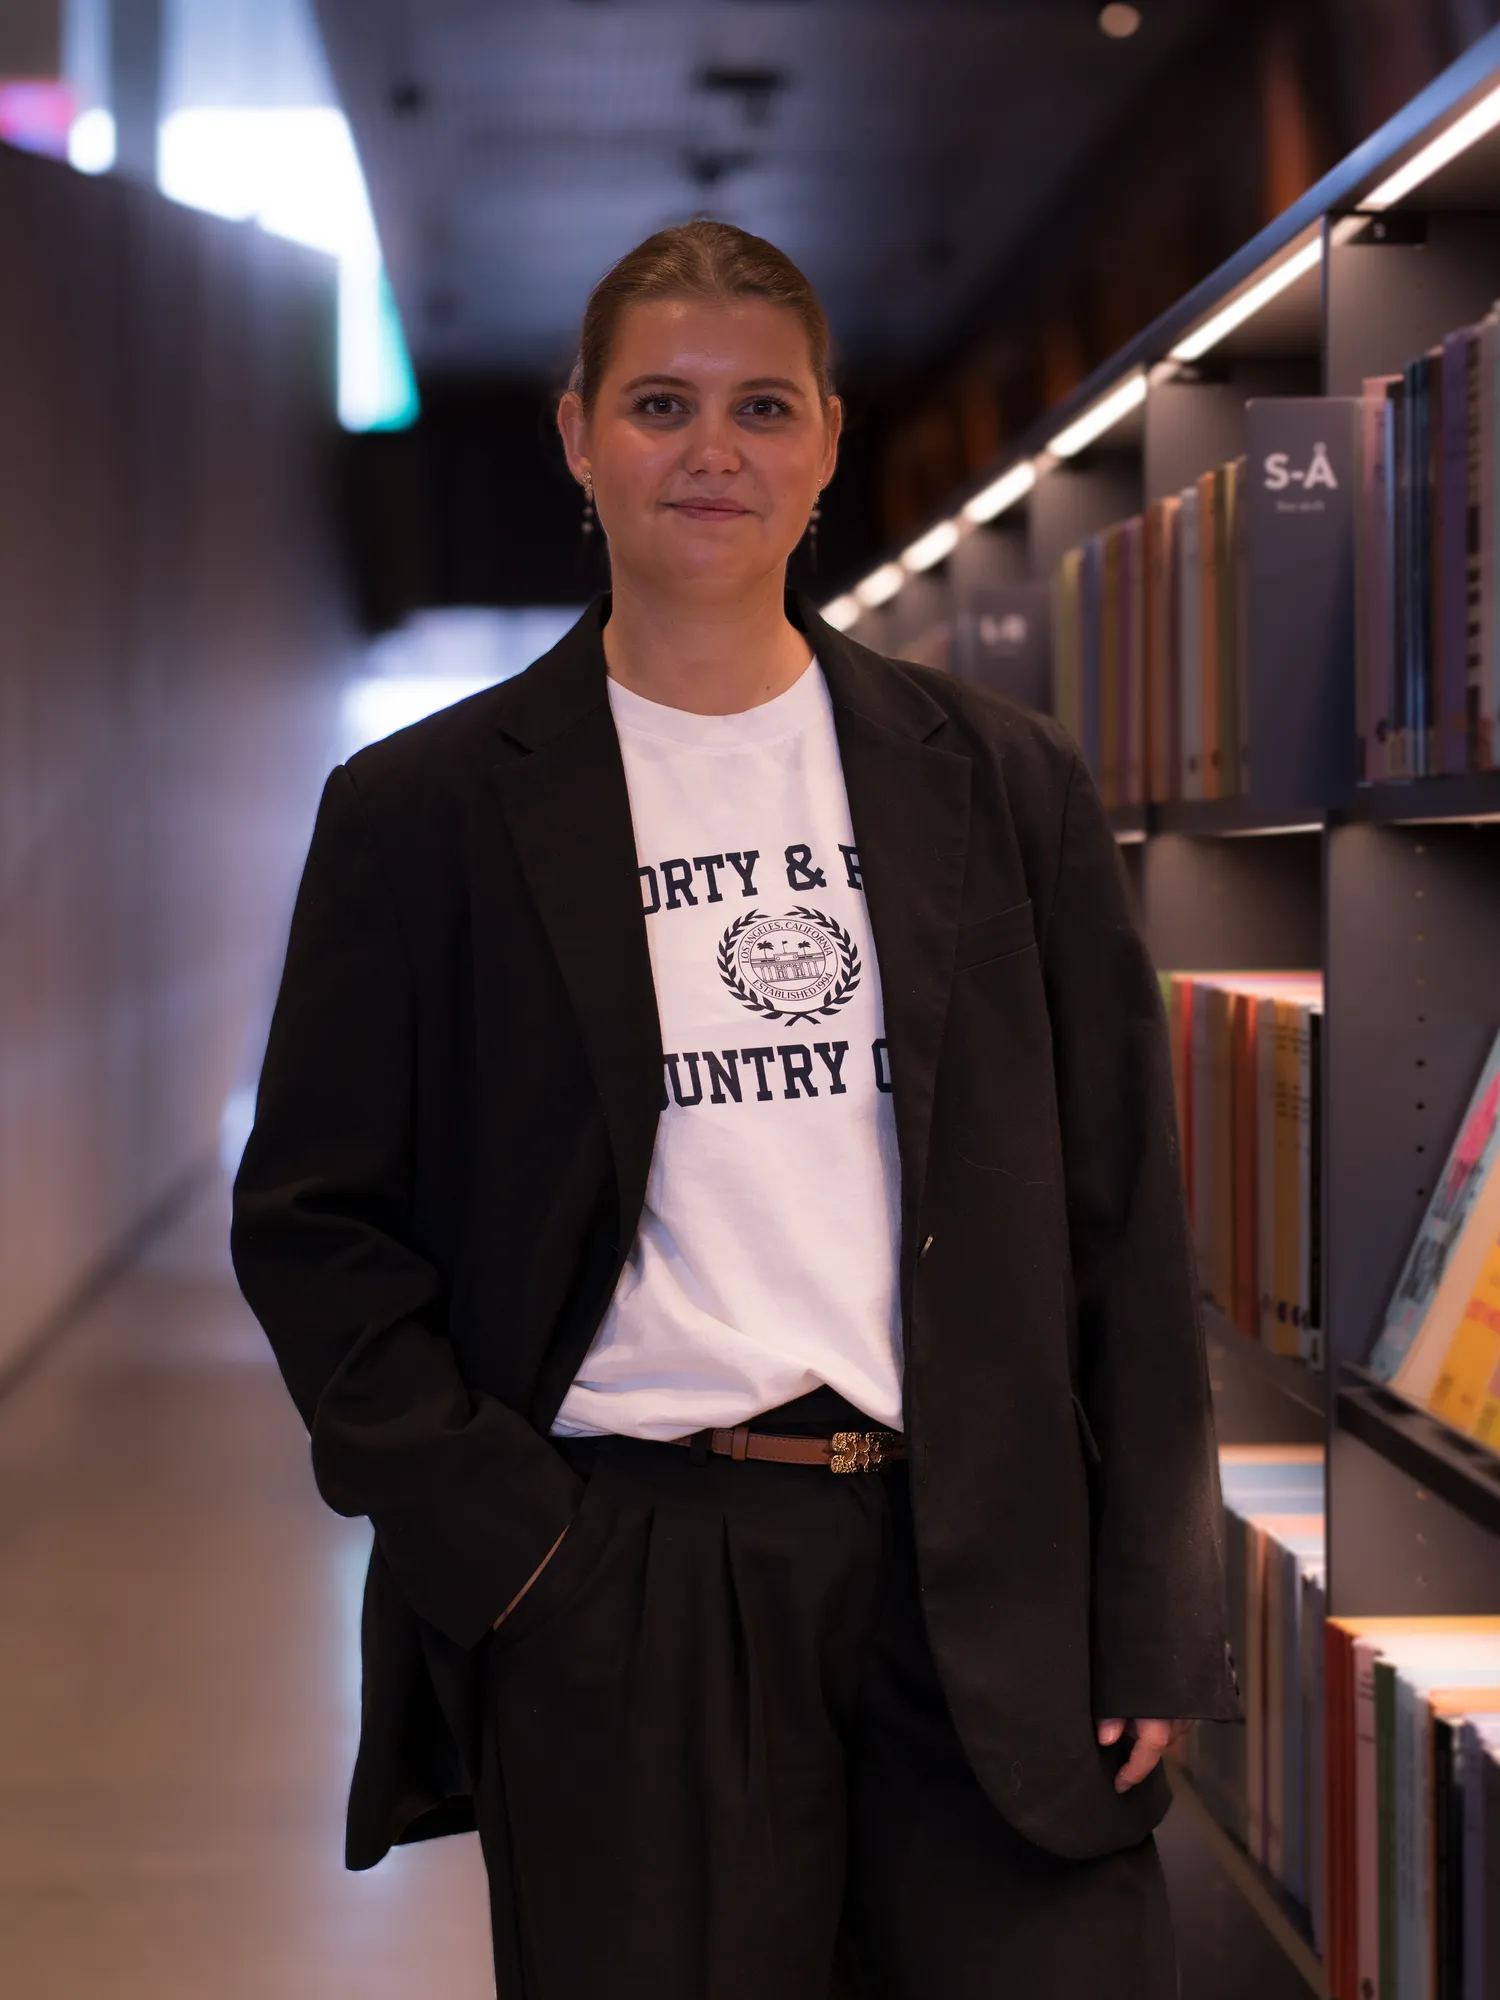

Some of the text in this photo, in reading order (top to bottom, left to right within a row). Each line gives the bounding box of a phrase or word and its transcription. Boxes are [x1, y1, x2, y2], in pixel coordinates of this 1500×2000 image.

[1264, 441, 1338, 490] S-Å
[784, 843, 827, 891] &
[740, 921, 833, 964] LOS ANGELES, CALIFORNIA
[752, 972, 833, 999] ESTABLISHED 1994
[660, 1040, 849, 1111] UNTRY
